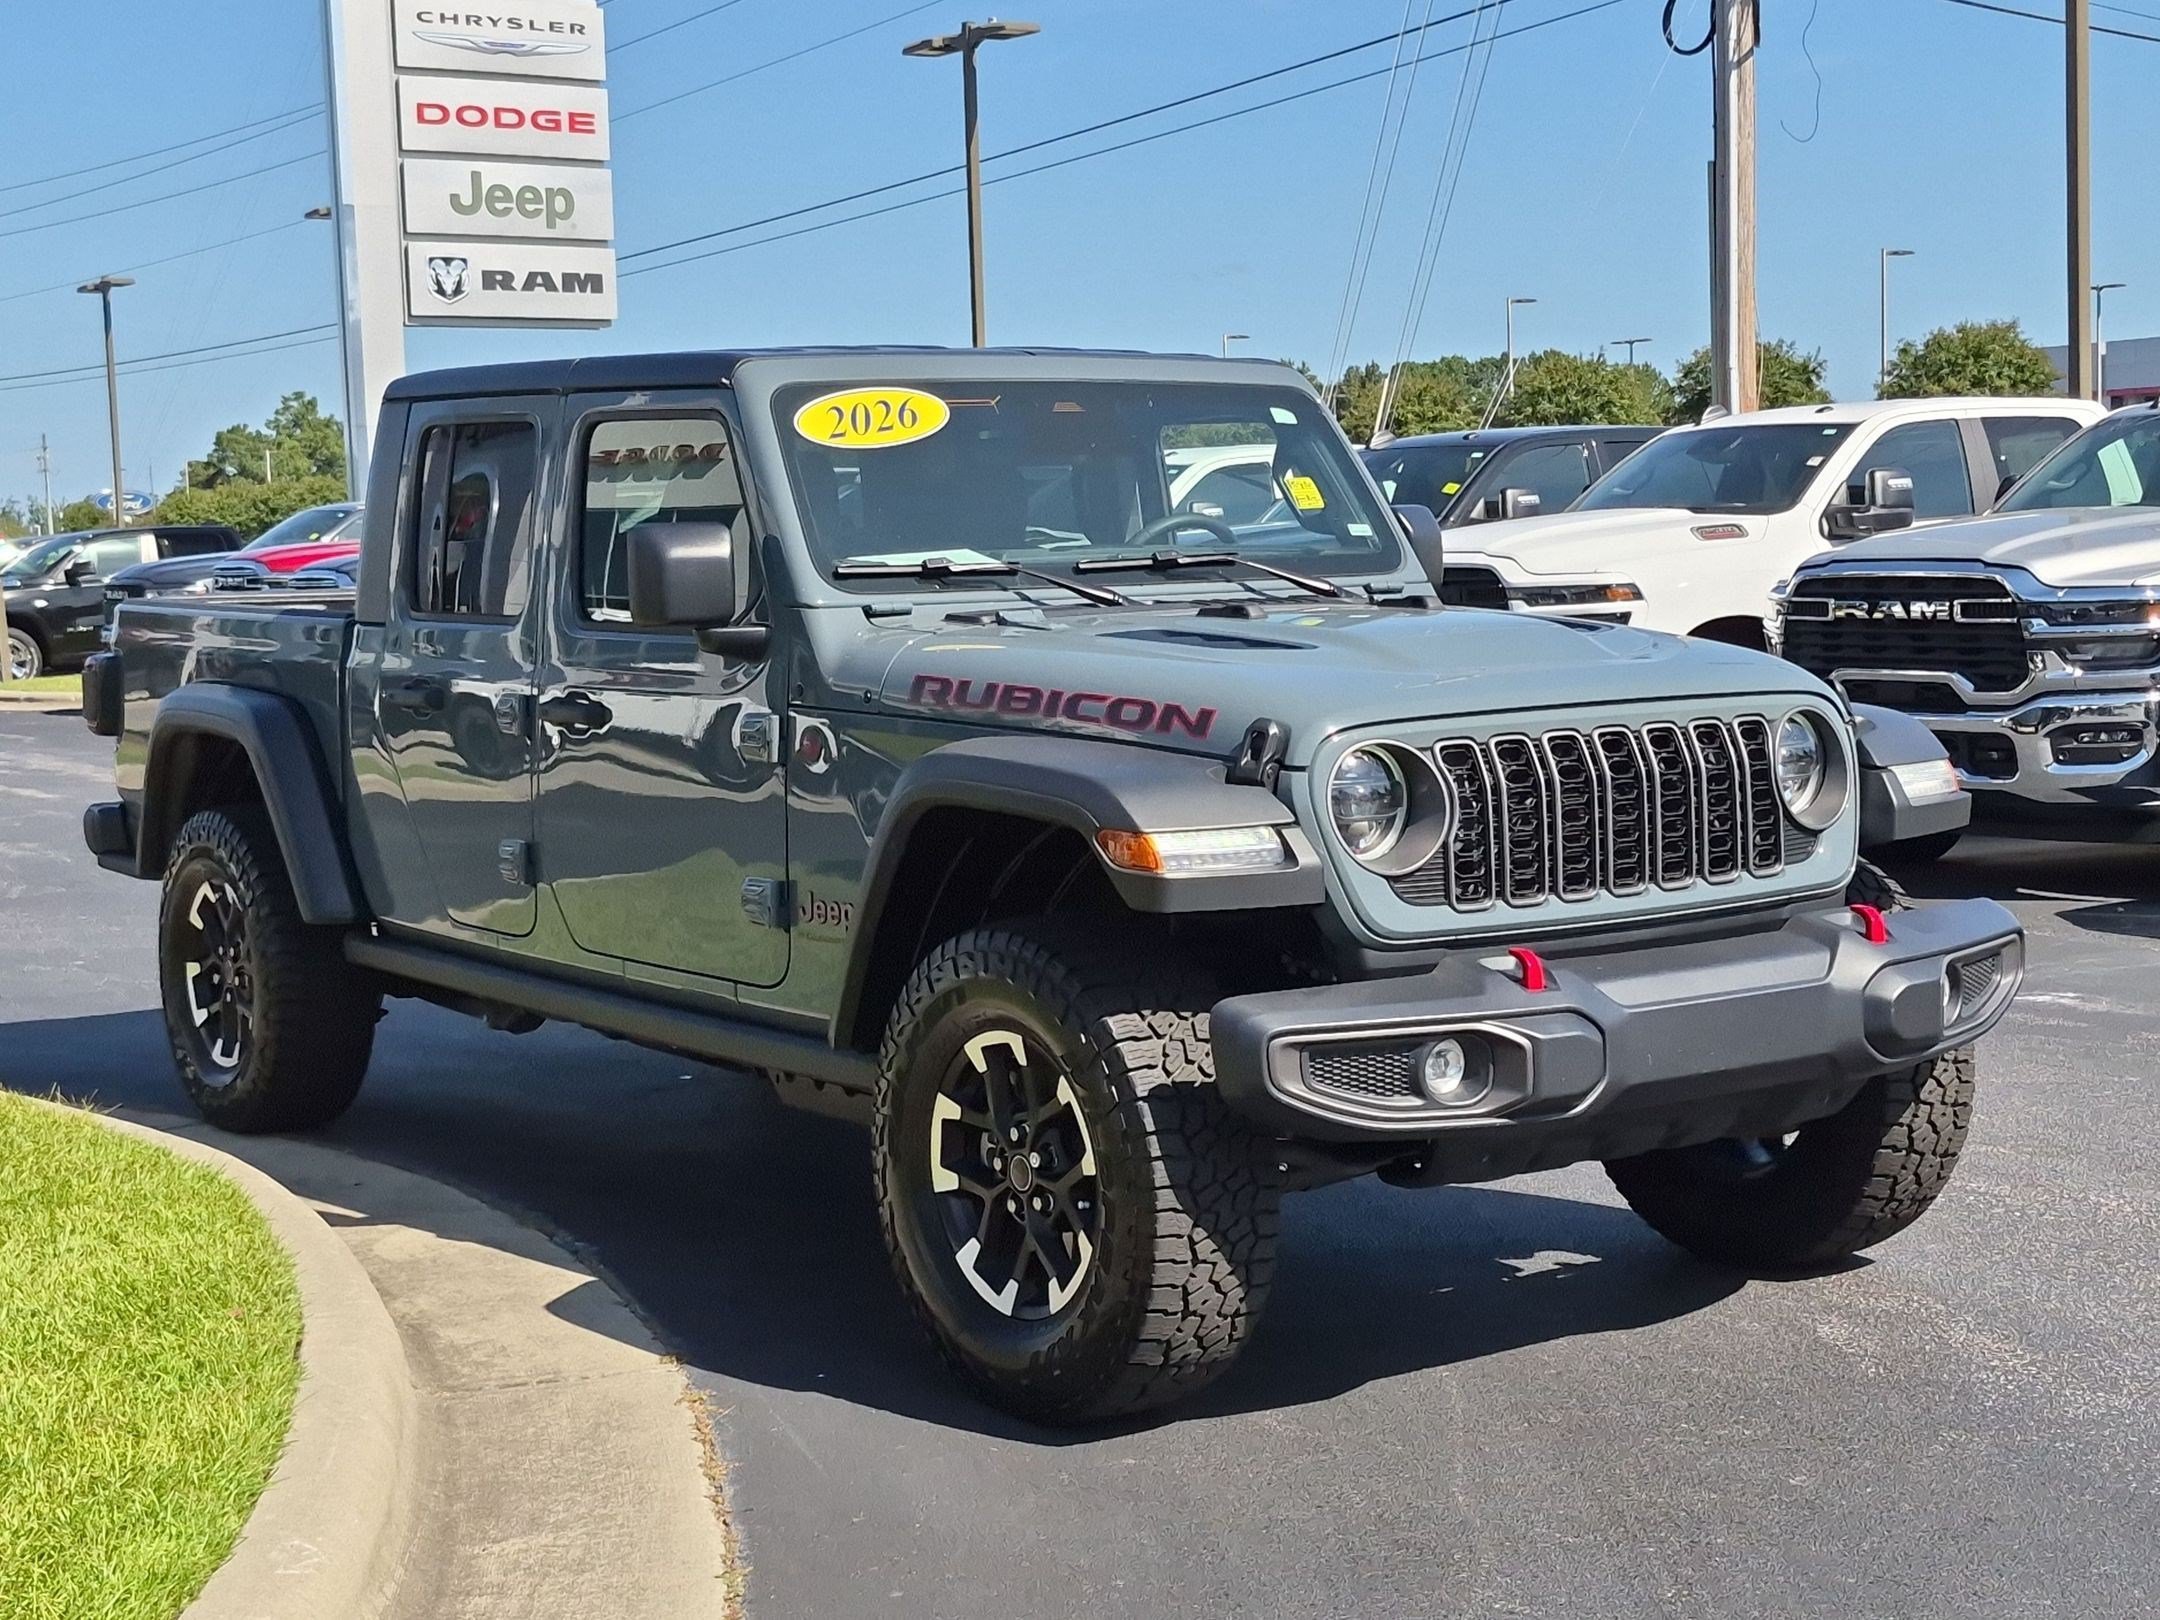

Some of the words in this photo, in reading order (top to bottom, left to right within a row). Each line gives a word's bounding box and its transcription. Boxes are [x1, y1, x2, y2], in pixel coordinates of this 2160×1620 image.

[416, 11, 587, 35] CHRYSLER
[416, 102, 596, 134] DODGE
[449, 170, 575, 229] Jeep
[481, 269, 604, 294] RAM
[826, 397, 918, 439] 2026
[1833, 601, 1950, 620] RAM
[908, 673, 1217, 740] RUBICON
[799, 889, 856, 934] Jeep
